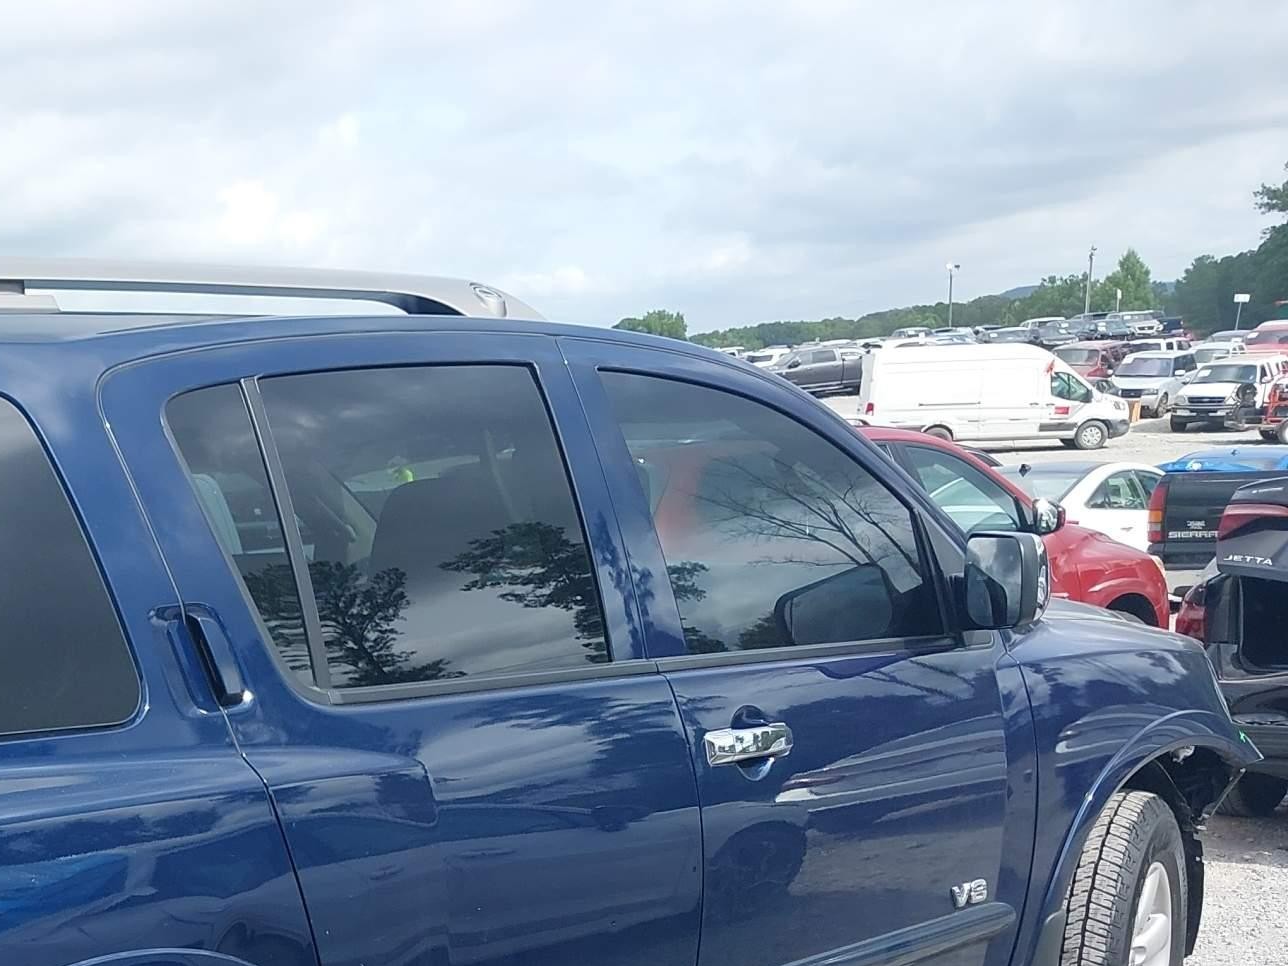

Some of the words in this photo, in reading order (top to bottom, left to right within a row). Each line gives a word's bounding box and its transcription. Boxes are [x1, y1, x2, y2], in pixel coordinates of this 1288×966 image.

[1168, 530, 1219, 539] SIERRA
[1223, 554, 1273, 566] JETTA
[951, 878, 987, 908] V8
